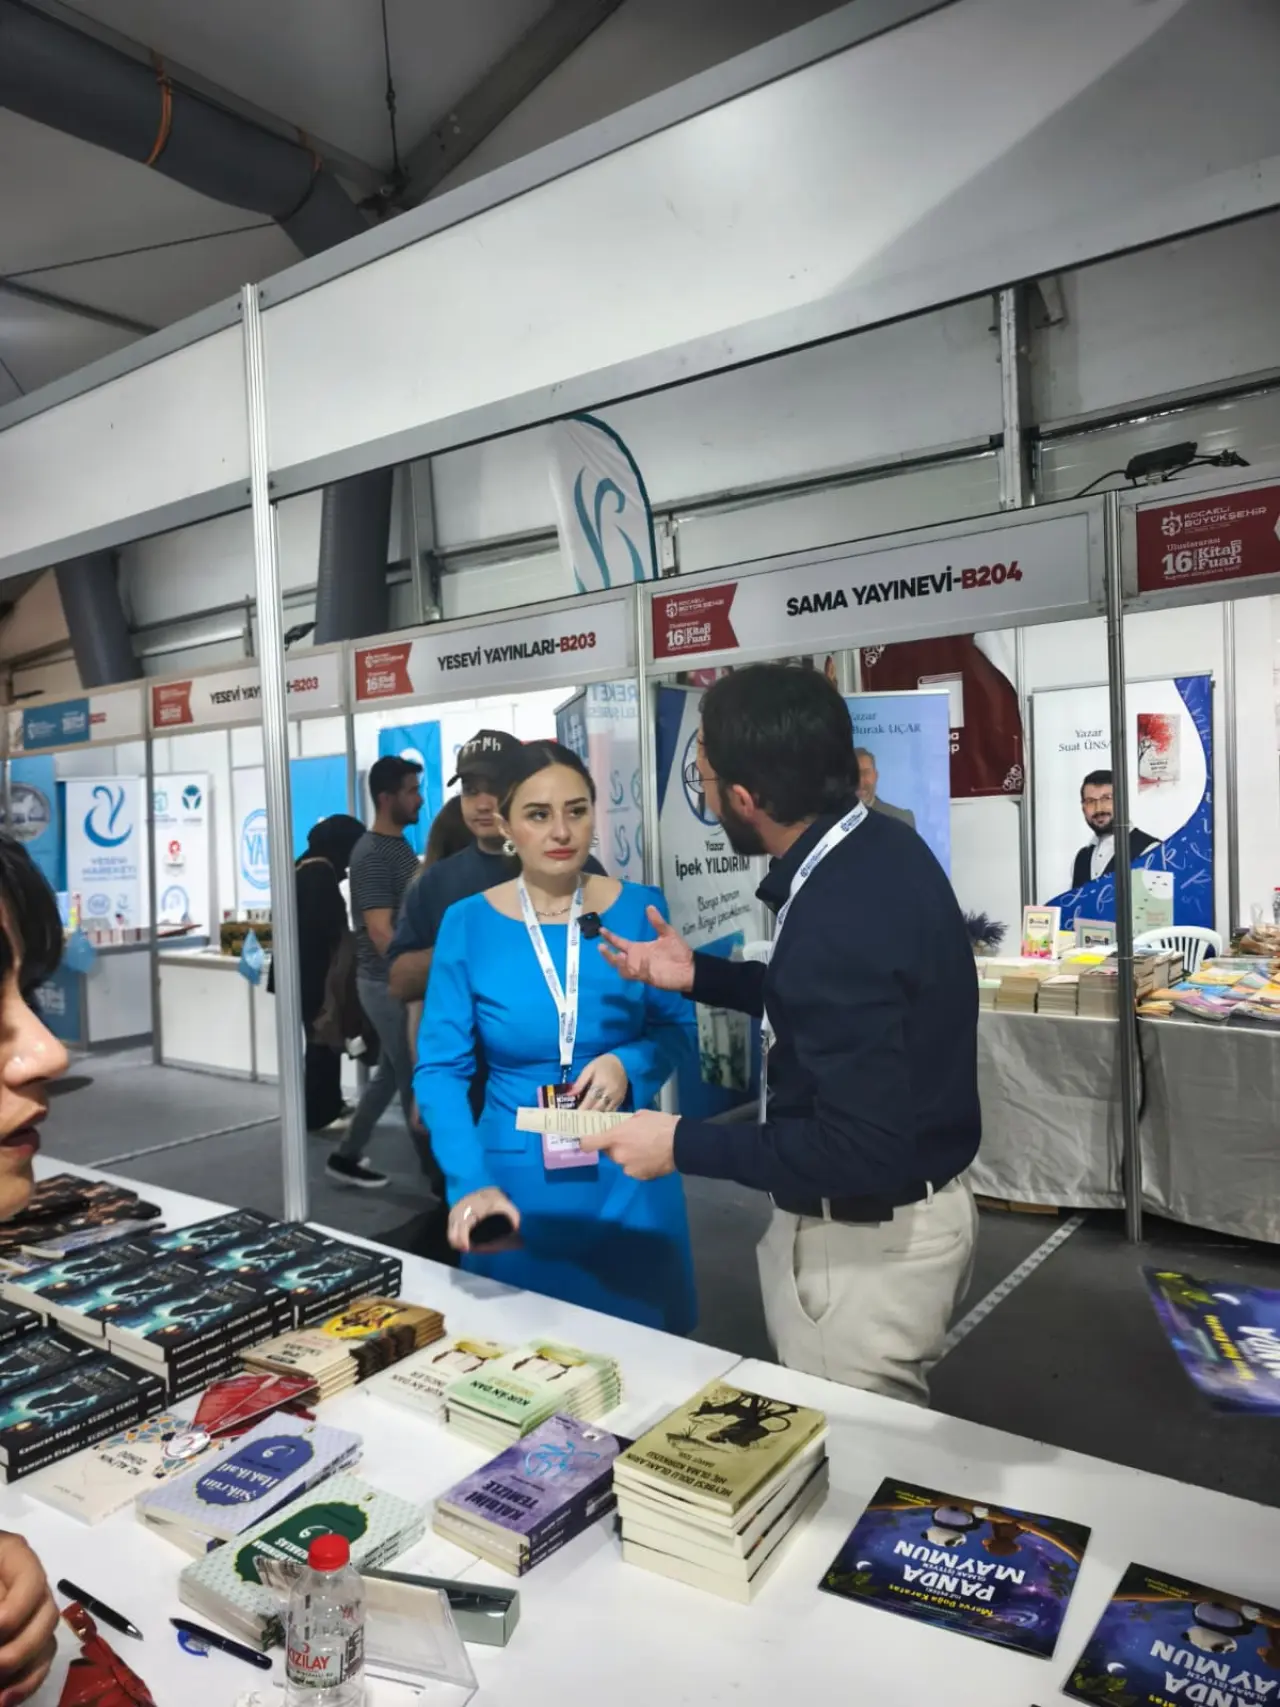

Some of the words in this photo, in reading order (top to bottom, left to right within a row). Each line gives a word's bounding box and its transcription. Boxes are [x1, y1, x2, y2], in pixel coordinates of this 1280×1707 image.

[1198, 541, 1242, 559] Kitap
[1162, 550, 1193, 575] 16
[1198, 556, 1242, 571] Fuarı
[787, 590, 848, 616] SAMA
[852, 561, 1023, 606] YAYINEVİ-B204
[666, 629, 684, 647] 16
[437, 646, 482, 671] YESEVİ
[483, 632, 596, 665] YAYINLARI-B203
[209, 685, 241, 705] YESEVİ
[851, 711, 877, 721] azar
[1075, 728, 1103, 739] Yazar
[1058, 742, 1080, 752] Suat
[704, 840, 725, 852] Yazar
[675, 854, 702, 880] İpek
[705, 855, 750, 874] YILDIRIM
[216, 1463, 280, 1489] Hakikati
[201, 1478, 257, 1502] Şükrün
[482, 1480, 539, 1509] TEMİZLE
[894, 1539, 1026, 1585] MAYMUN
[903, 1564, 996, 1601] PANDA
[931, 1595, 957, 1610] Doğa
[959, 1600, 994, 1617] Merve
[1150, 1639, 1280, 1700] AYMUN
[1165, 1671, 1264, 1707] ANDA
